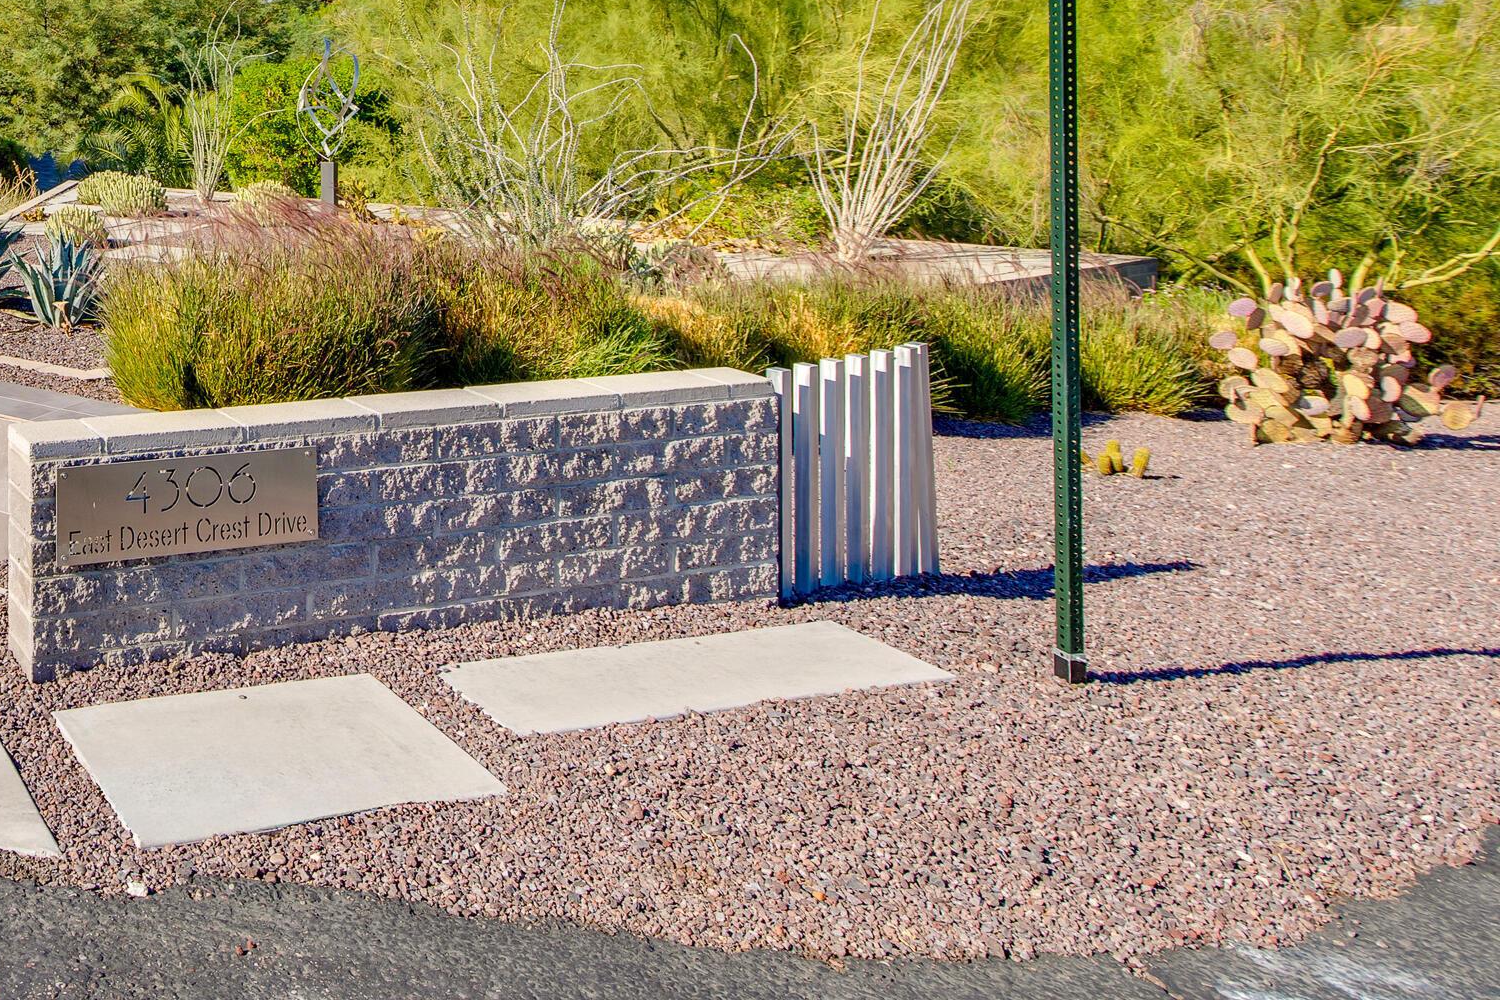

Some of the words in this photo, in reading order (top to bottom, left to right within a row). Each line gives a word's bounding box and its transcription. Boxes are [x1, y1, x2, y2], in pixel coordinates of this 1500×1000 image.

[125, 463, 256, 514] 4306
[69, 530, 112, 556] East
[120, 521, 189, 551] Desert
[196, 516, 251, 542] Crest
[258, 512, 307, 537] Drive
